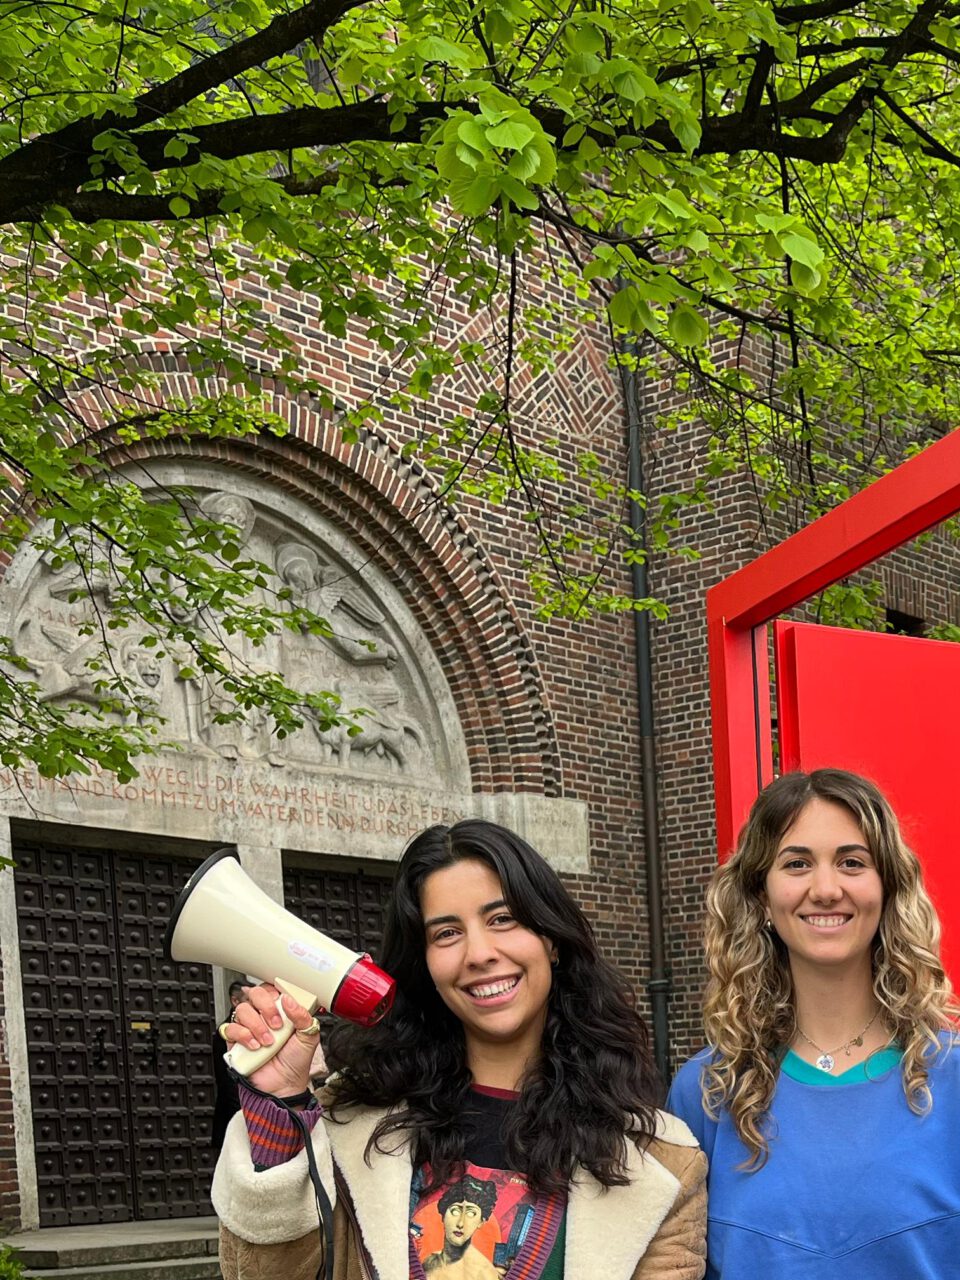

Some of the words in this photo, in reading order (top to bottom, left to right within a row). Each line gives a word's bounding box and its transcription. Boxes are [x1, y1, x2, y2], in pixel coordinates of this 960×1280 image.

[112, 783, 189, 809] KOMMT
[193, 793, 238, 818] ZUM
[240, 801, 301, 825] VATER
[303, 808, 355, 832] DENN
[249, 779, 358, 810] WAHRHEIT
